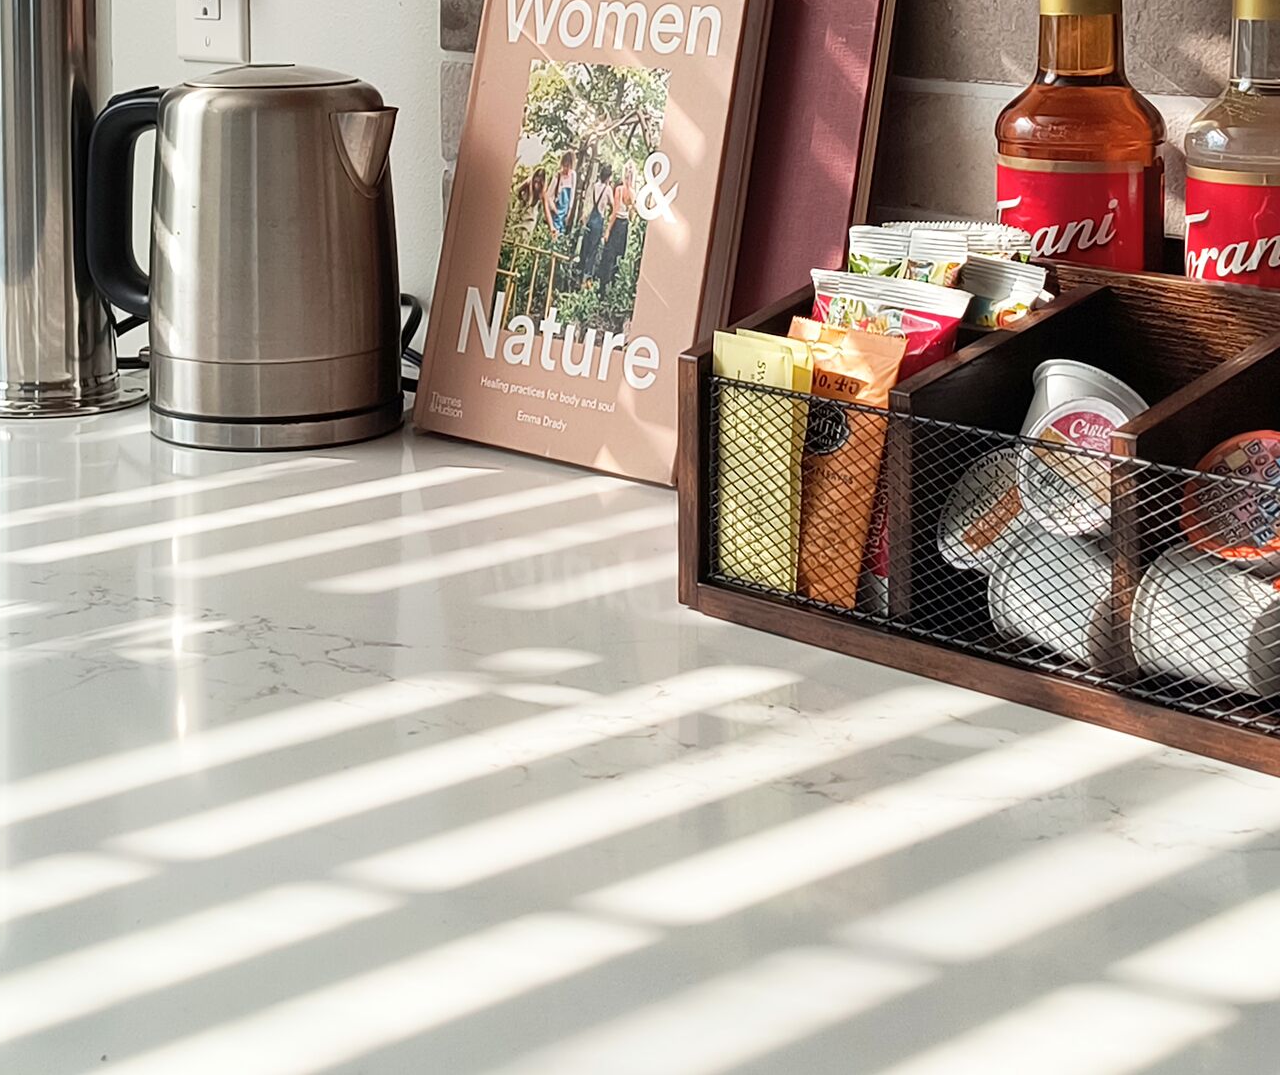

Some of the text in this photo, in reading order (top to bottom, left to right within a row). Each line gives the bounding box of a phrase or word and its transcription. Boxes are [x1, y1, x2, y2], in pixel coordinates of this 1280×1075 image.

[636, 151, 678, 224] &
[457, 286, 660, 390] Nature
[431, 391, 462, 408] Thames
[480, 375, 616, 413] Healing practices for body and soul
[516, 410, 567, 432] Emma Drady
